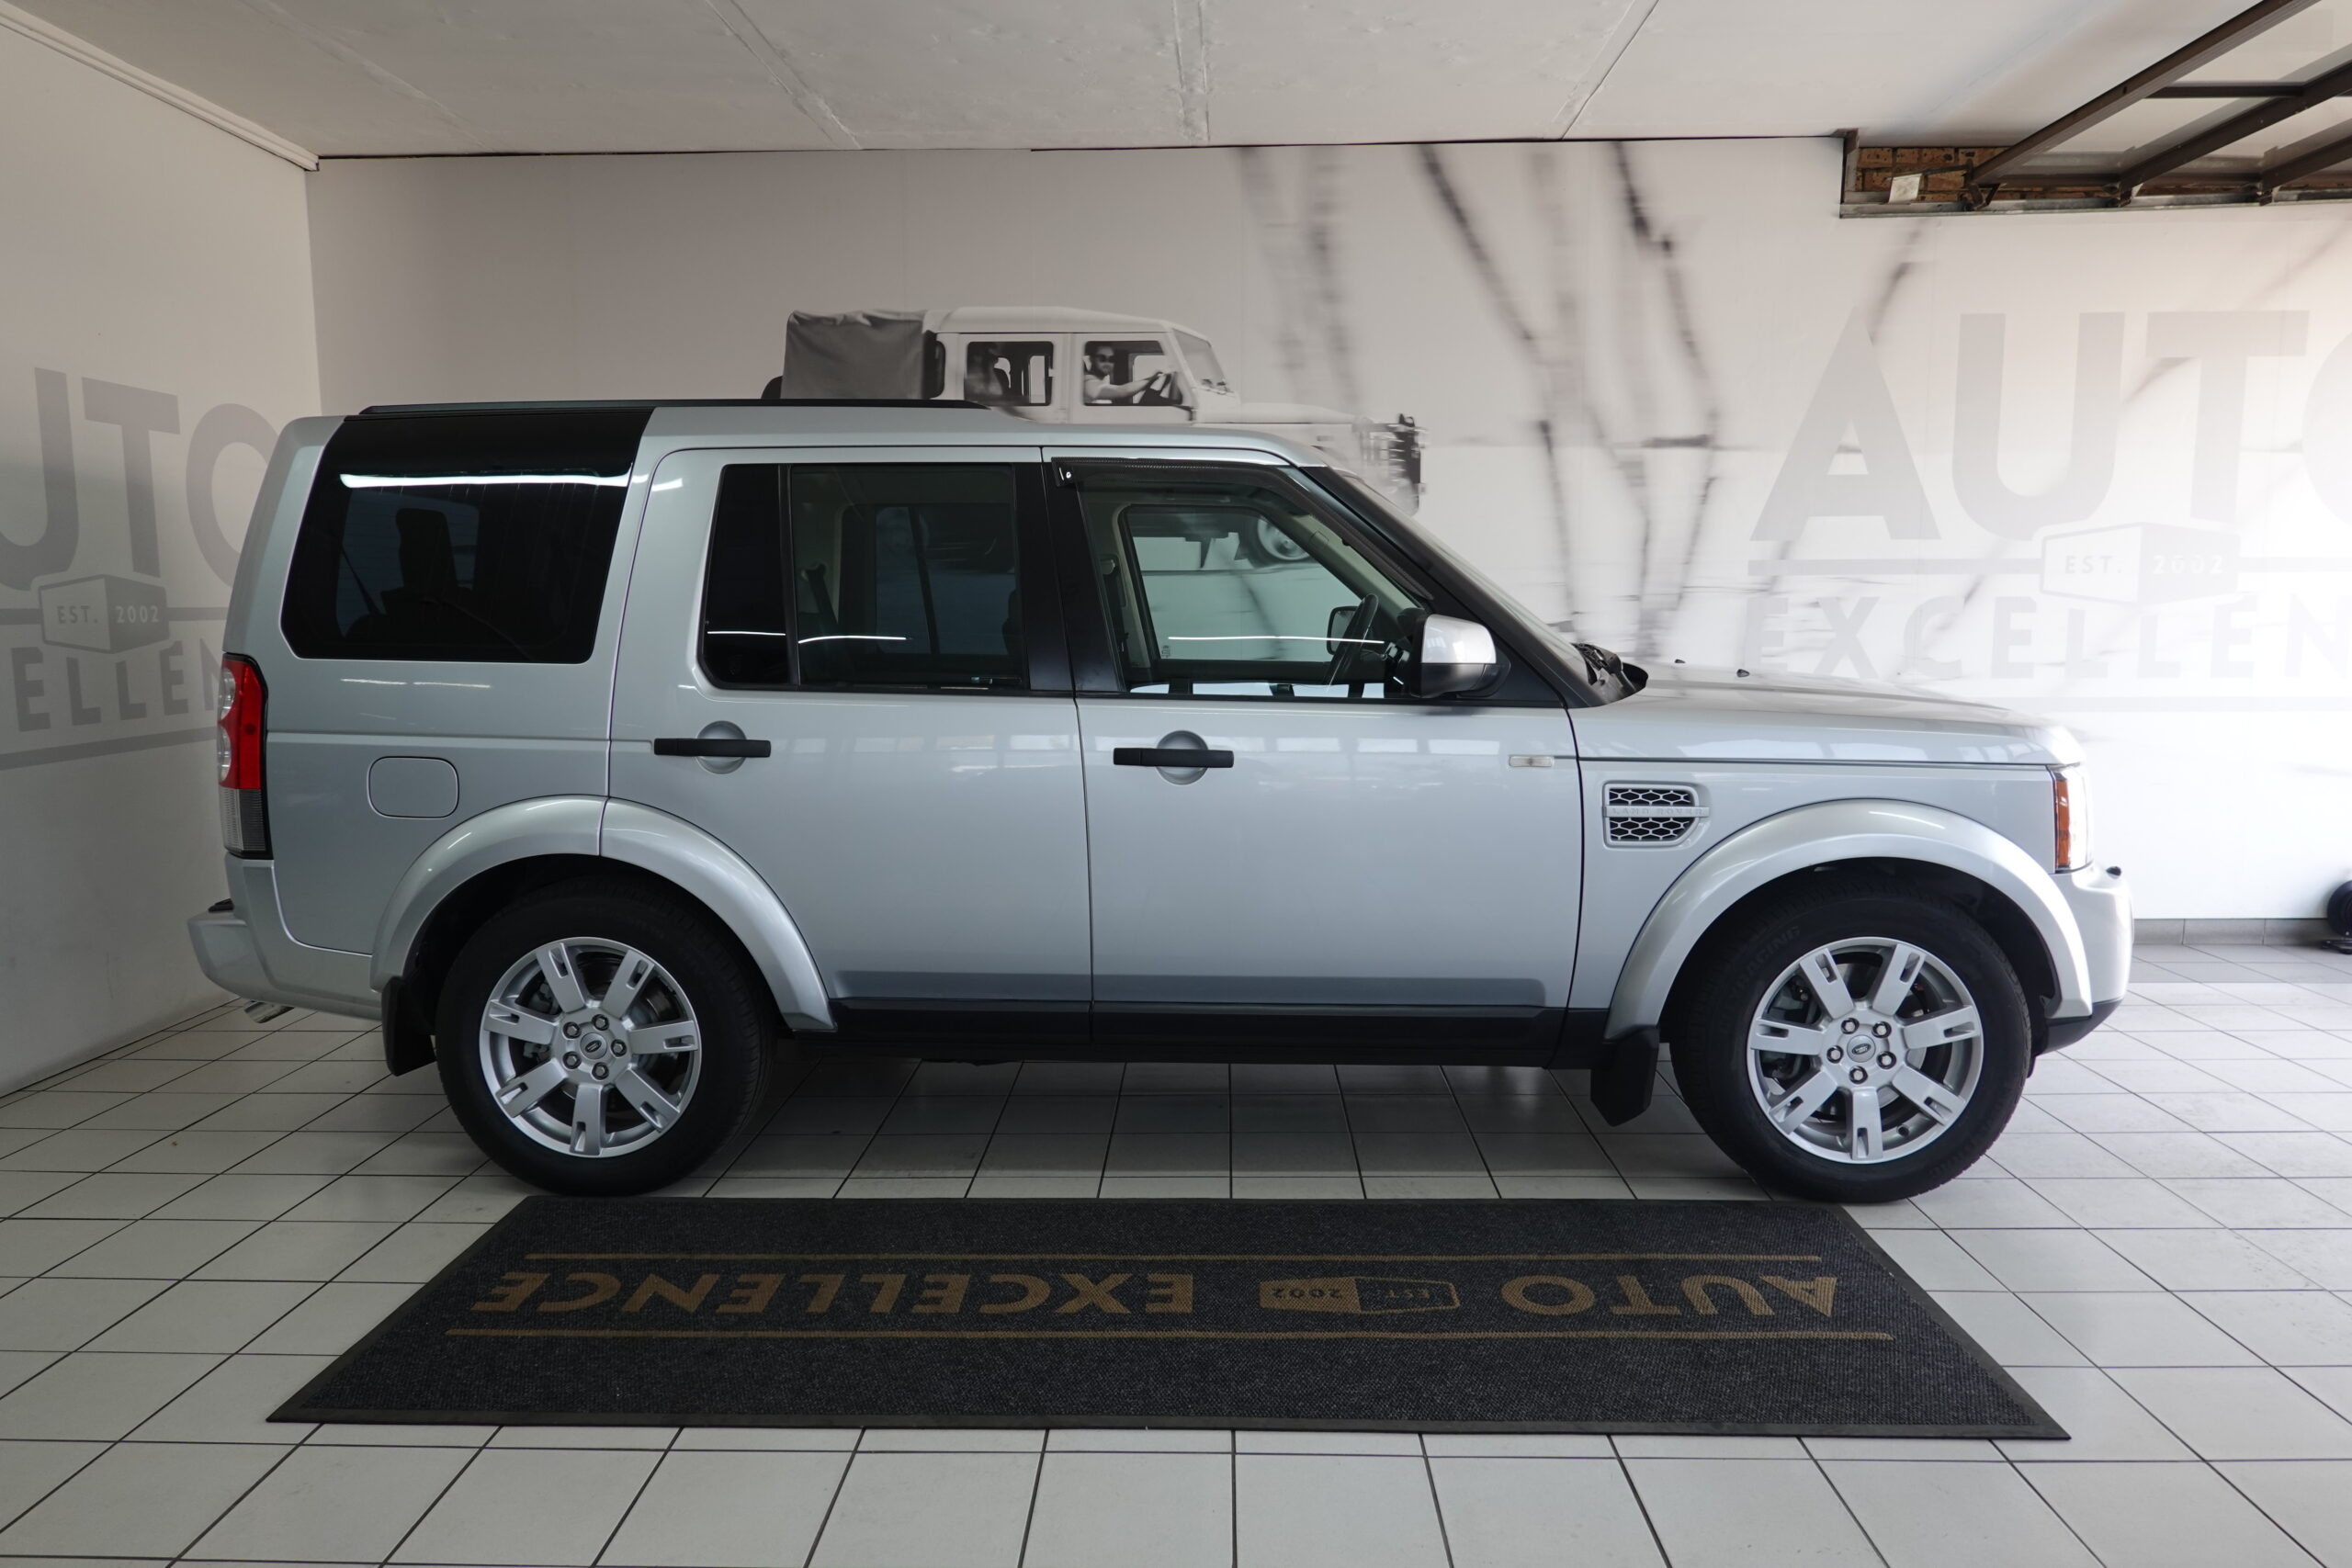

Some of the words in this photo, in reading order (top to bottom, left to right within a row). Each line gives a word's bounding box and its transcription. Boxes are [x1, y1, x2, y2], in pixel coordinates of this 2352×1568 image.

[2064, 555, 2121, 574] EST.
[2153, 555, 2222, 574] 2002
[57, 604, 98, 624] EST.
[116, 604, 159, 623] 2002
[1611, 807, 1650, 816] LAND
[471, 1271, 1193, 1314] EXCELLENCE
[1272, 1288, 1342, 1299] 2002
[1502, 1274, 1838, 1317] AUTO
